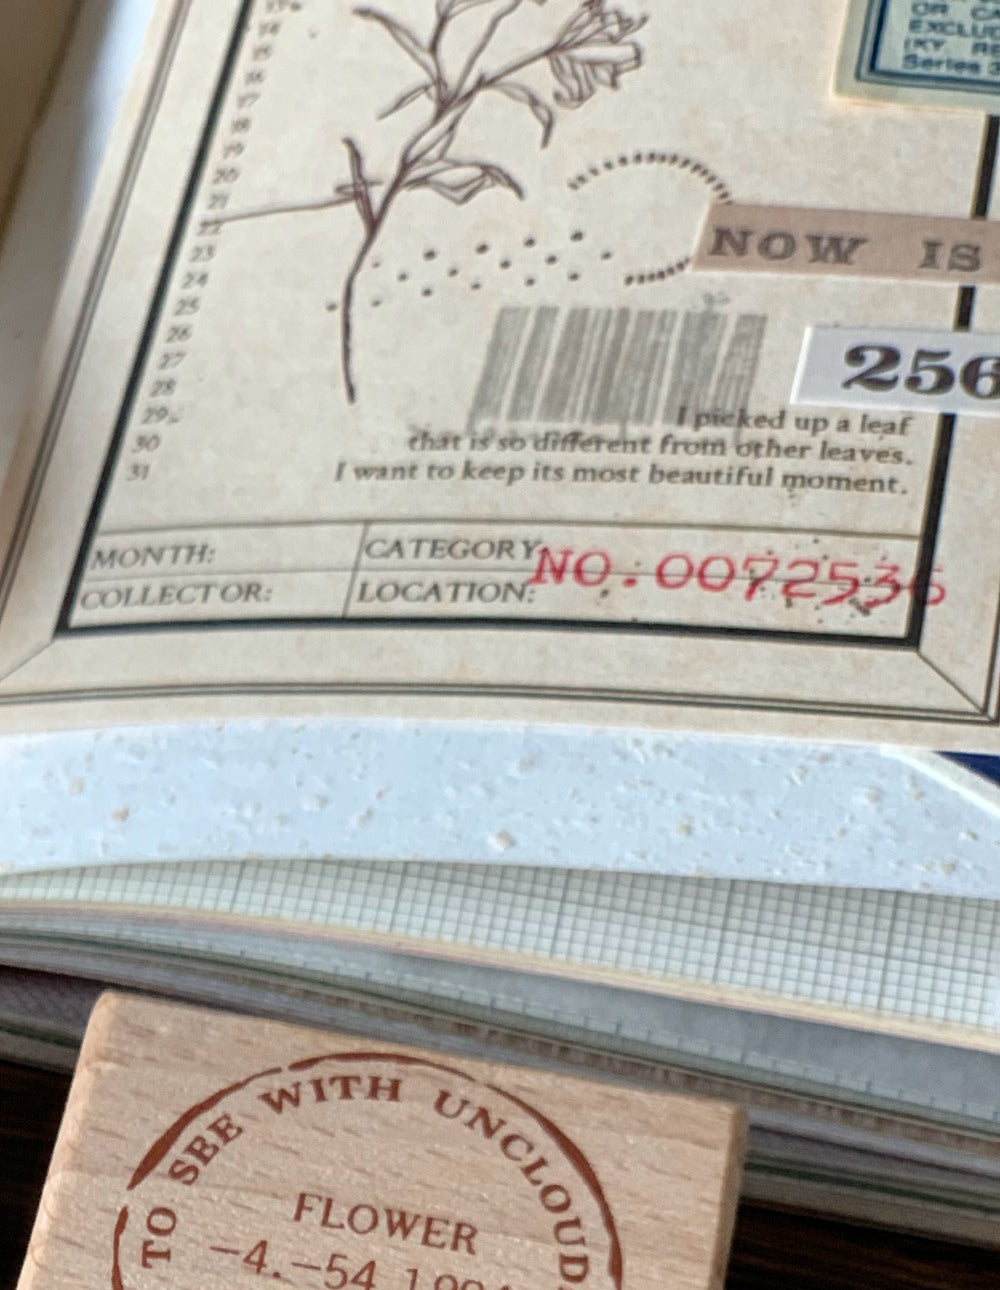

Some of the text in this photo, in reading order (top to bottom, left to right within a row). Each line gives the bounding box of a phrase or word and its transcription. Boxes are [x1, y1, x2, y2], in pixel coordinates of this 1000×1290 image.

[212, 167, 239, 184] 20
[207, 193, 229, 210] 21
[190, 245, 215, 262] 23
[708, 226, 982, 271] NOW IS
[182, 271, 208, 289] 24
[174, 297, 200, 316] 25
[166, 324, 192, 343] 26
[158, 351, 186, 370] 27
[840, 343, 1000, 400] 256
[150, 378, 176, 398] 28
[142, 405, 168, 424] 29
[677, 406, 913, 437] I picked up a leaf
[131, 433, 161, 453] 30
[408, 430, 913, 465] that is so different from other leaves.
[126, 462, 150, 482] 31
[334, 460, 908, 495] I want to keep its most beautiful moment.
[91, 544, 217, 571] MONTH:
[79, 581, 273, 611] COLLECTOR:
[359, 581, 536, 604] LOCATION:
[141, 1206, 177, 1269] TO
[168, 1111, 244, 1186] SEE
[258, 1075, 404, 1115] WITH
[293, 1192, 479, 1256] FLOWER
